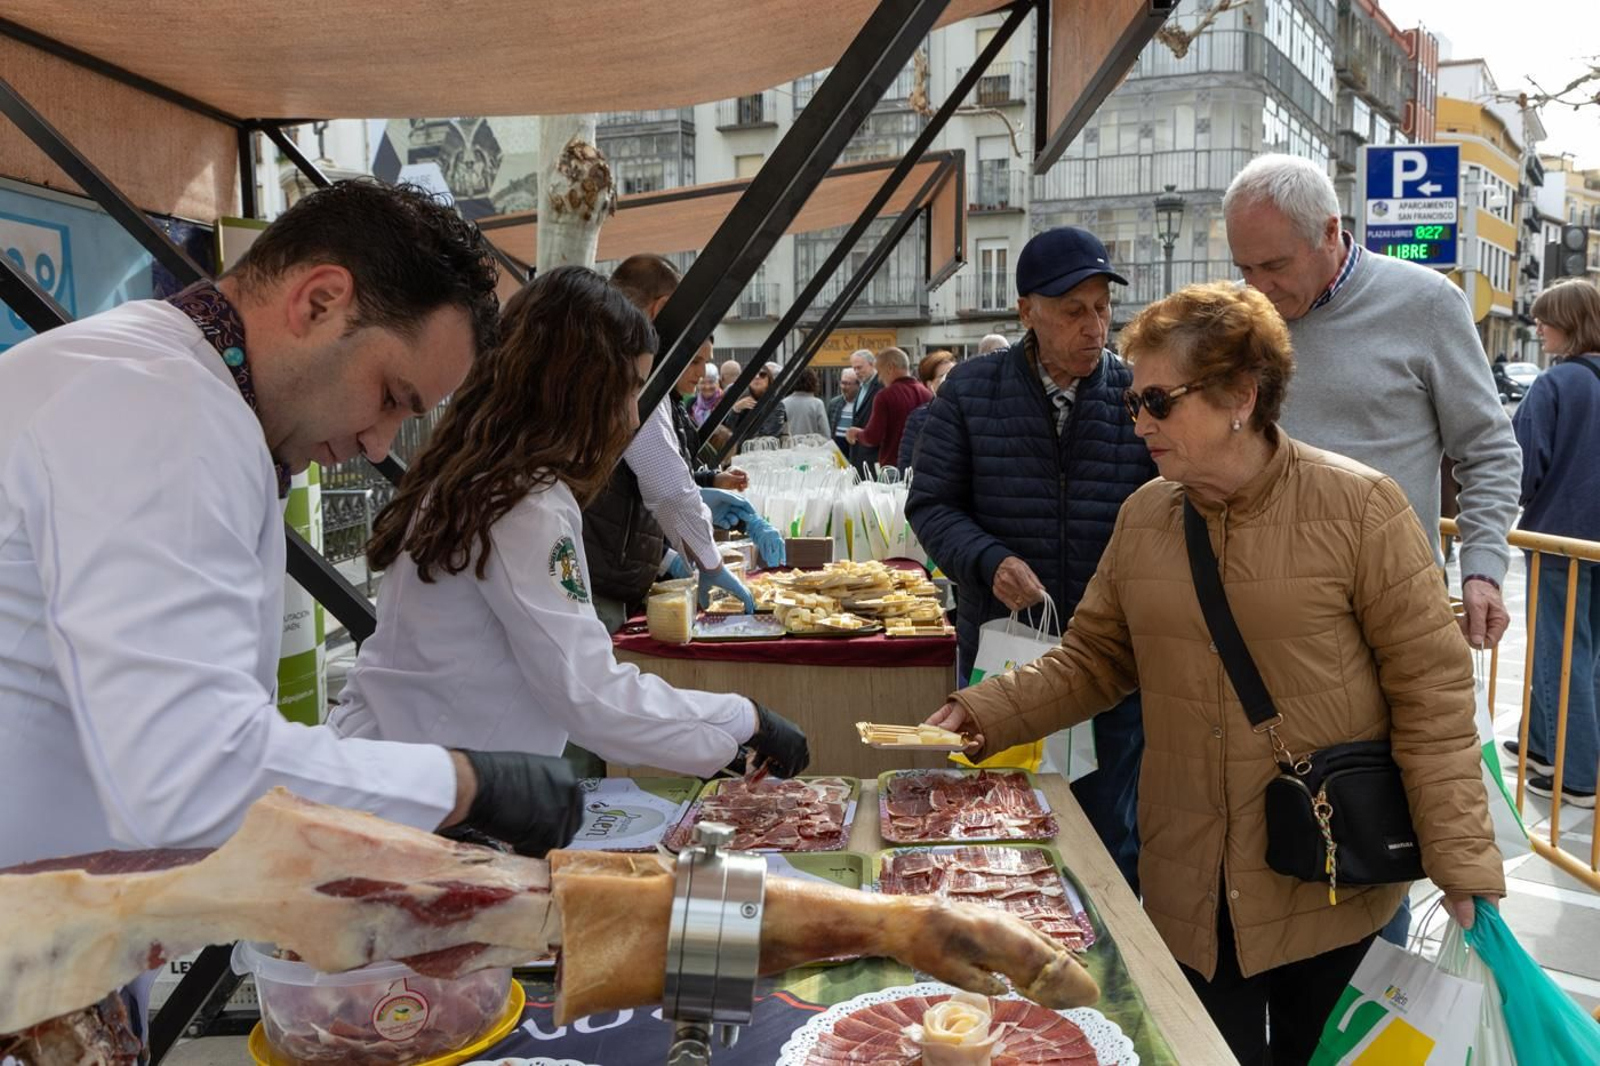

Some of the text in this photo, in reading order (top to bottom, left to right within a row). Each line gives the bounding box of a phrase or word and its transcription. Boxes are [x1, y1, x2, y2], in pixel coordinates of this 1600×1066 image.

[1392, 150, 1428, 198] P
[1398, 201, 1454, 210] APARCAMIENTO
[1398, 211, 1454, 221] SAN FRANCISCO
[1367, 229, 1413, 239] PLAZAS LIBRES
[1415, 225, 1444, 240] 027
[1387, 243, 1429, 260] LIBRE
[171, 961, 193, 974] LE
